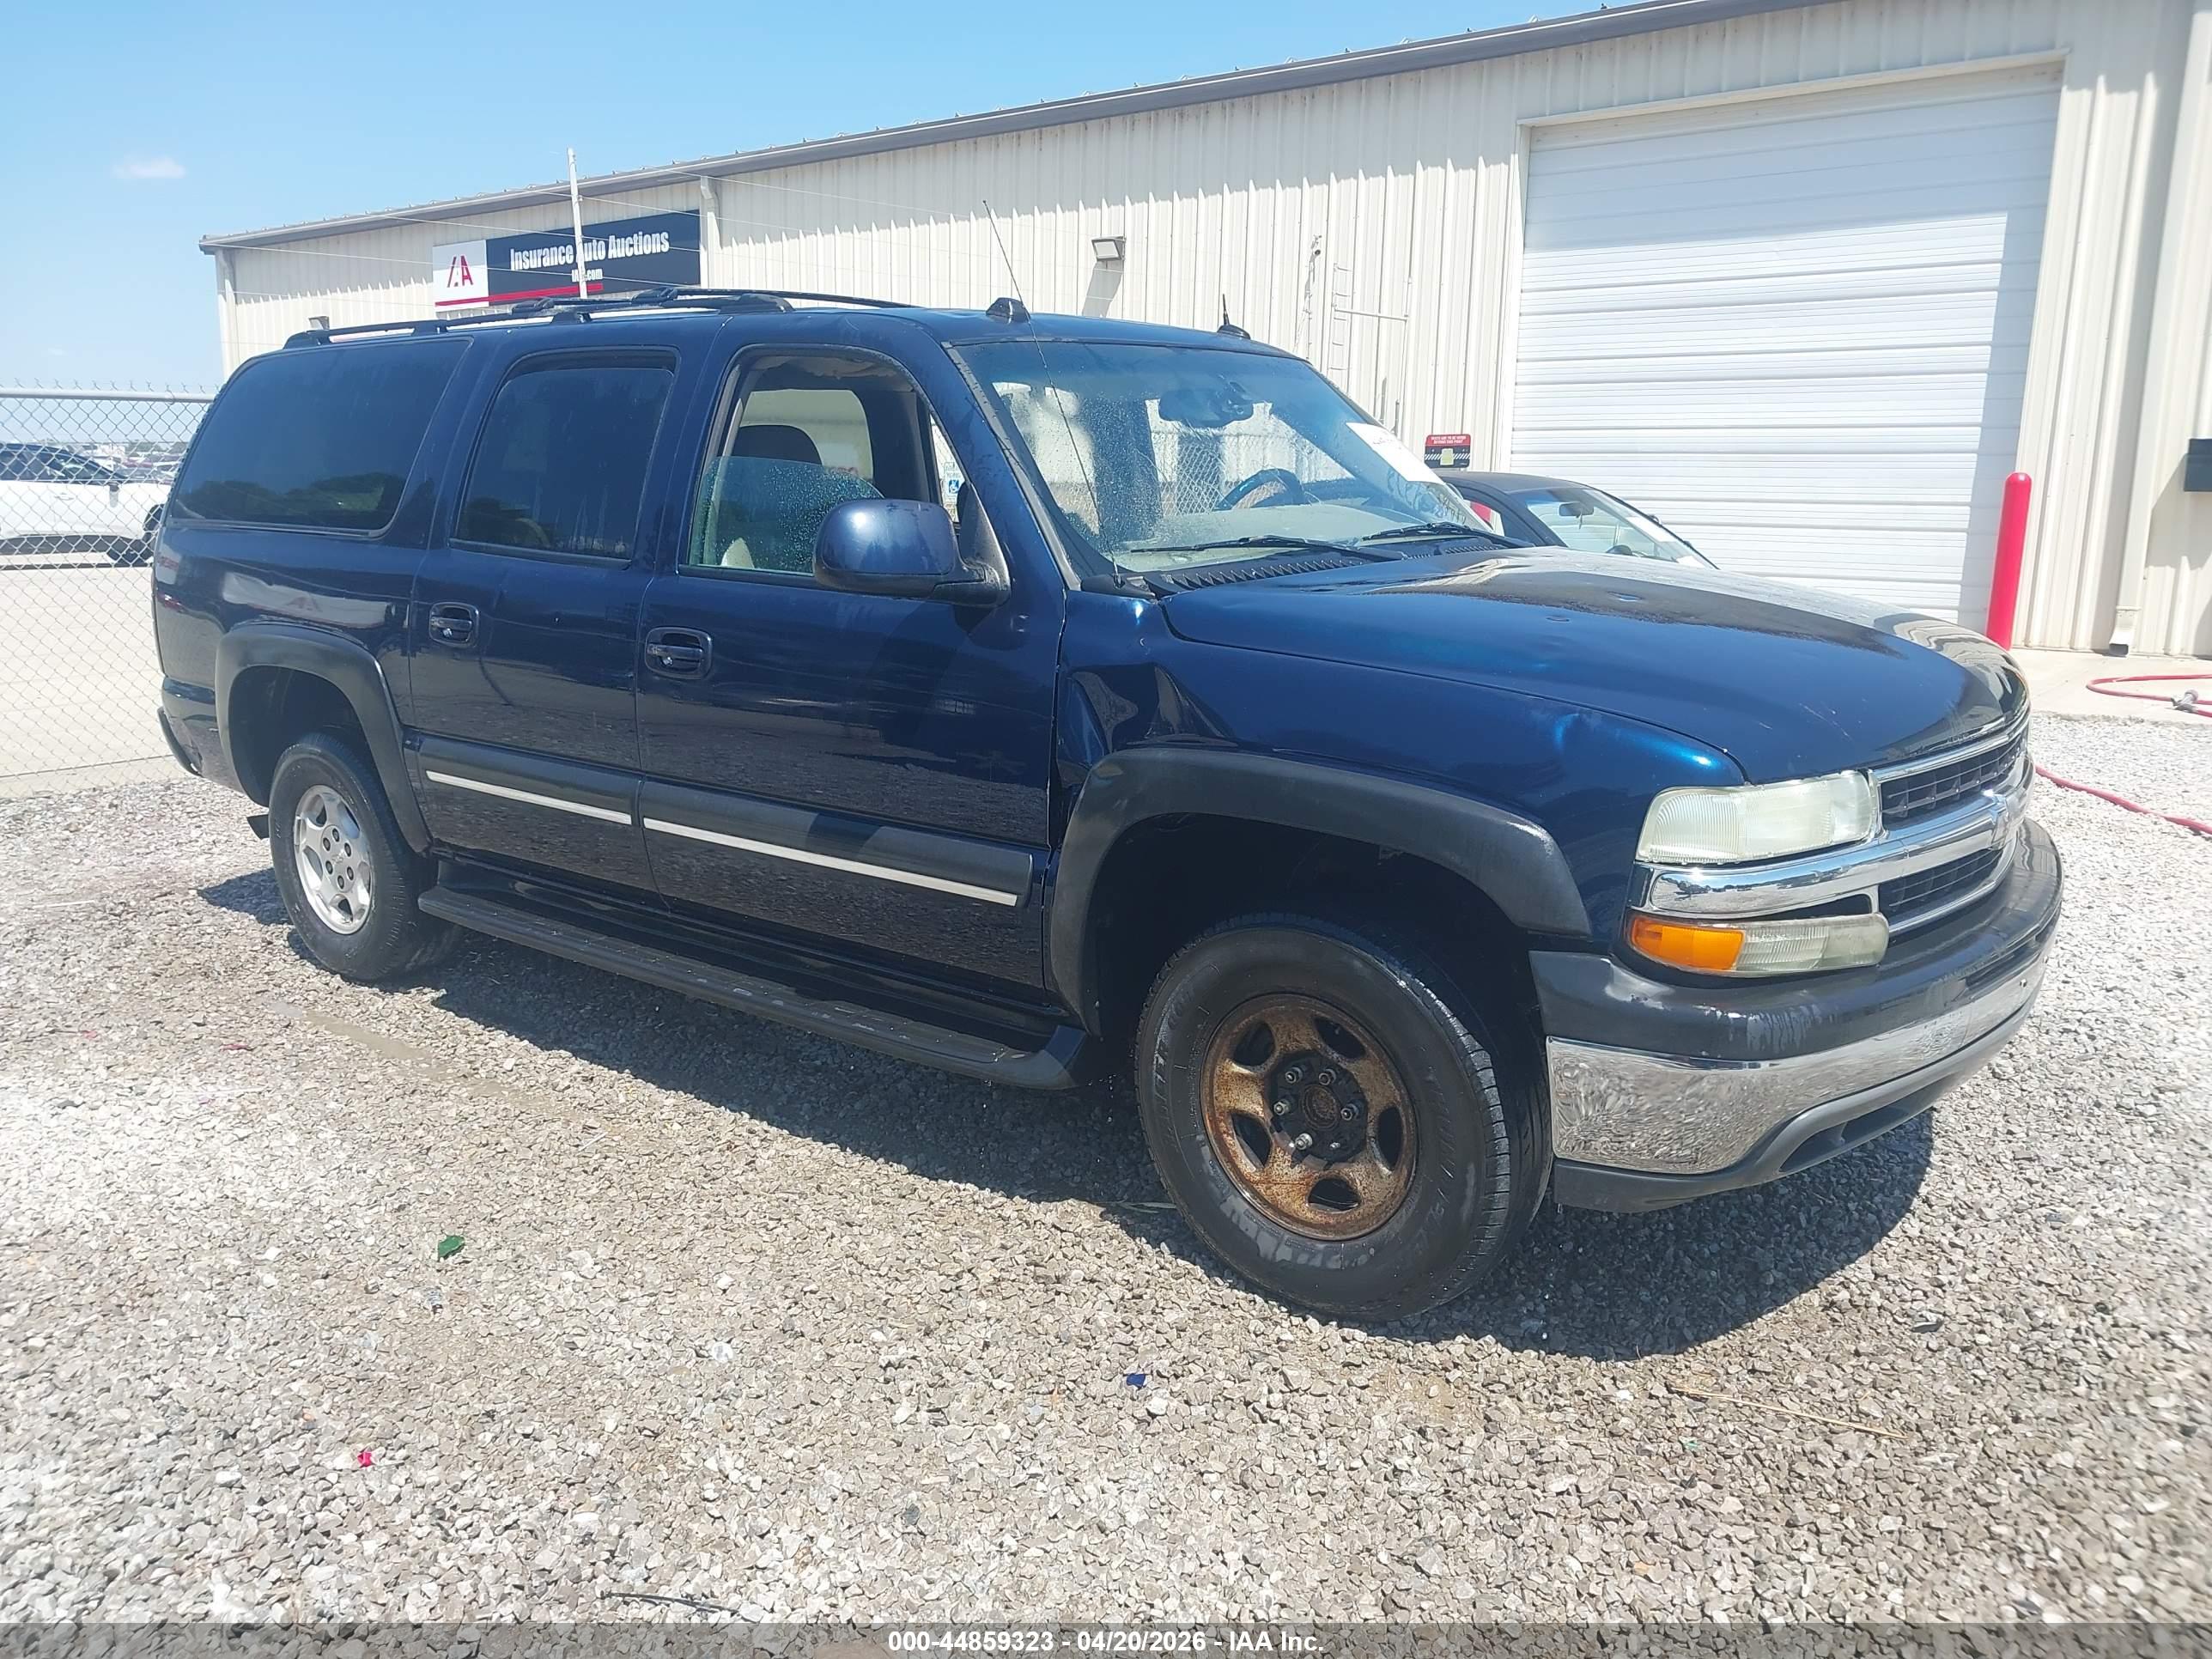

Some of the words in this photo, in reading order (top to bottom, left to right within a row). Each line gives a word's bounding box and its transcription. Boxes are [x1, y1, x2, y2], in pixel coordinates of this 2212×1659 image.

[510, 244, 574, 271] Insurance
[576, 239, 606, 263] uto
[607, 231, 670, 259] Auctions
